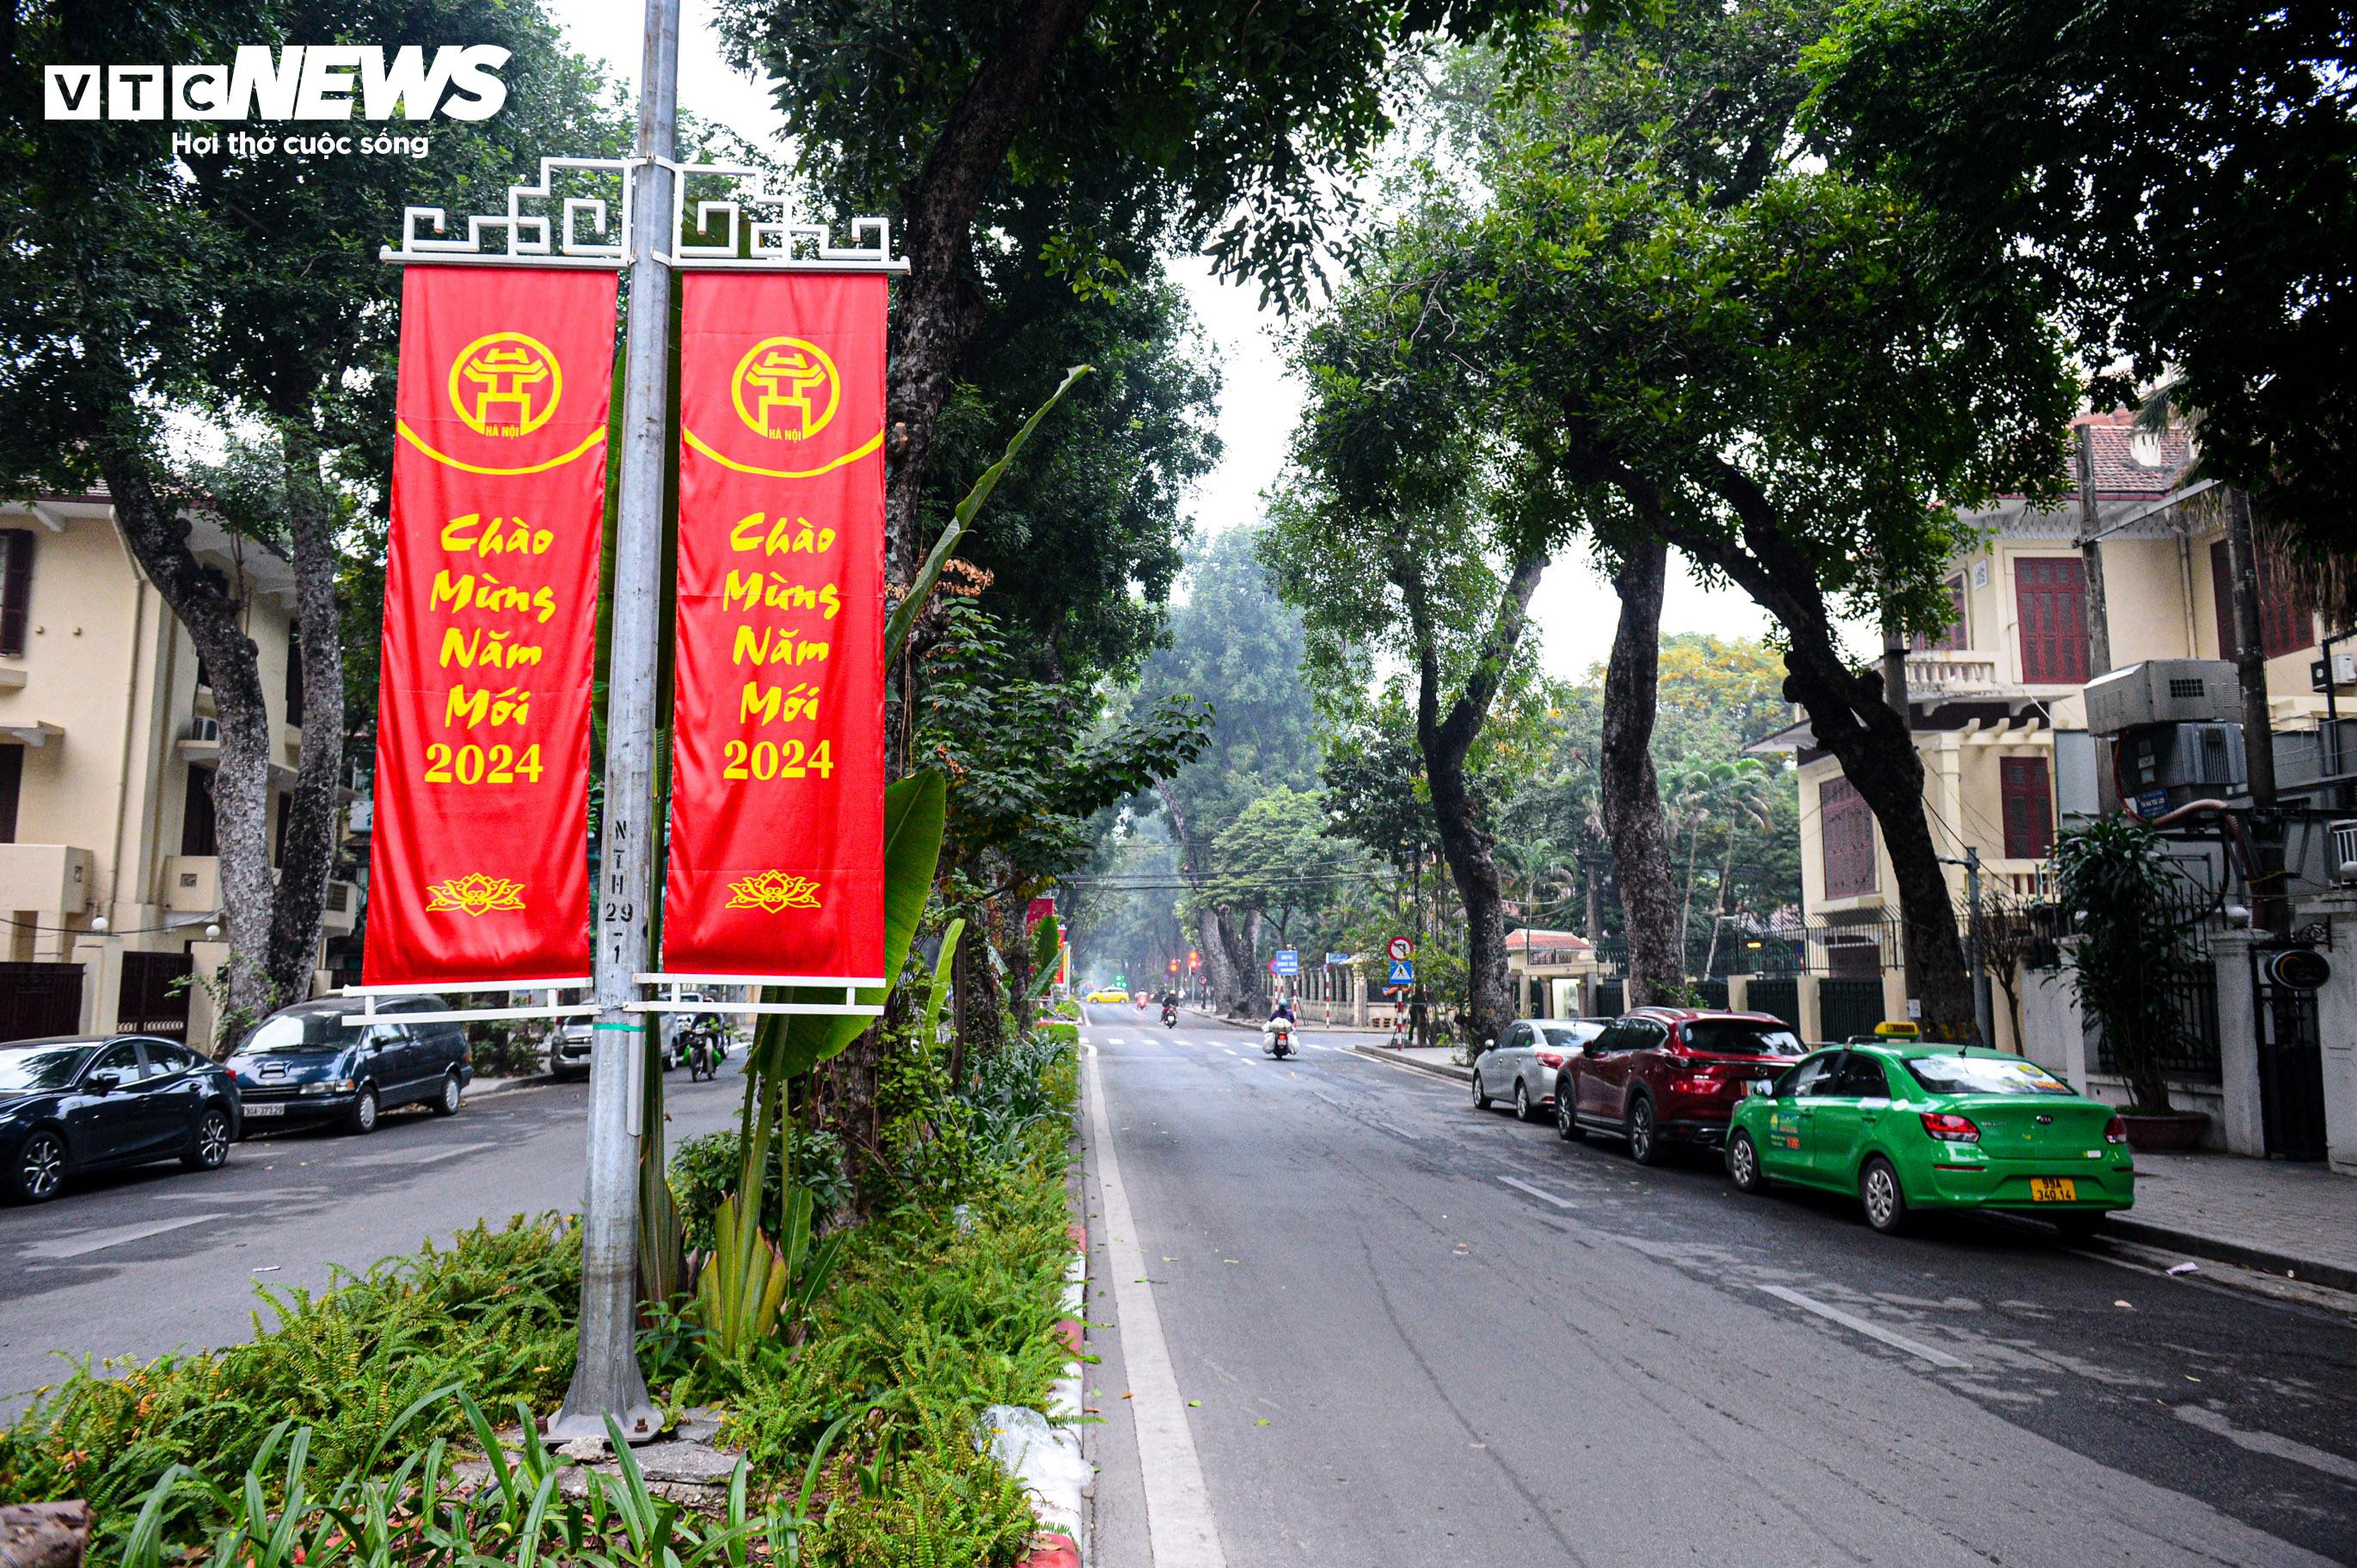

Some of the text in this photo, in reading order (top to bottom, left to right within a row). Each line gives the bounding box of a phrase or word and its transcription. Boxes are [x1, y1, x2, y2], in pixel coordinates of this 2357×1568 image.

[485, 424, 519, 439] HÀ NỘI
[769, 427, 801, 443] HÀ NỘI
[441, 512, 555, 558] Chào
[730, 511, 837, 556] Chào
[430, 569, 556, 623] Mừng
[723, 568, 841, 620] Mừng
[439, 627, 543, 670] Năm
[733, 624, 830, 666] Năm
[445, 683, 531, 730] Mới
[740, 681, 820, 726] Mới
[424, 743, 544, 785] 2024
[722, 738, 834, 781] 2024
[2042, 1178, 2062, 1189] 99A
